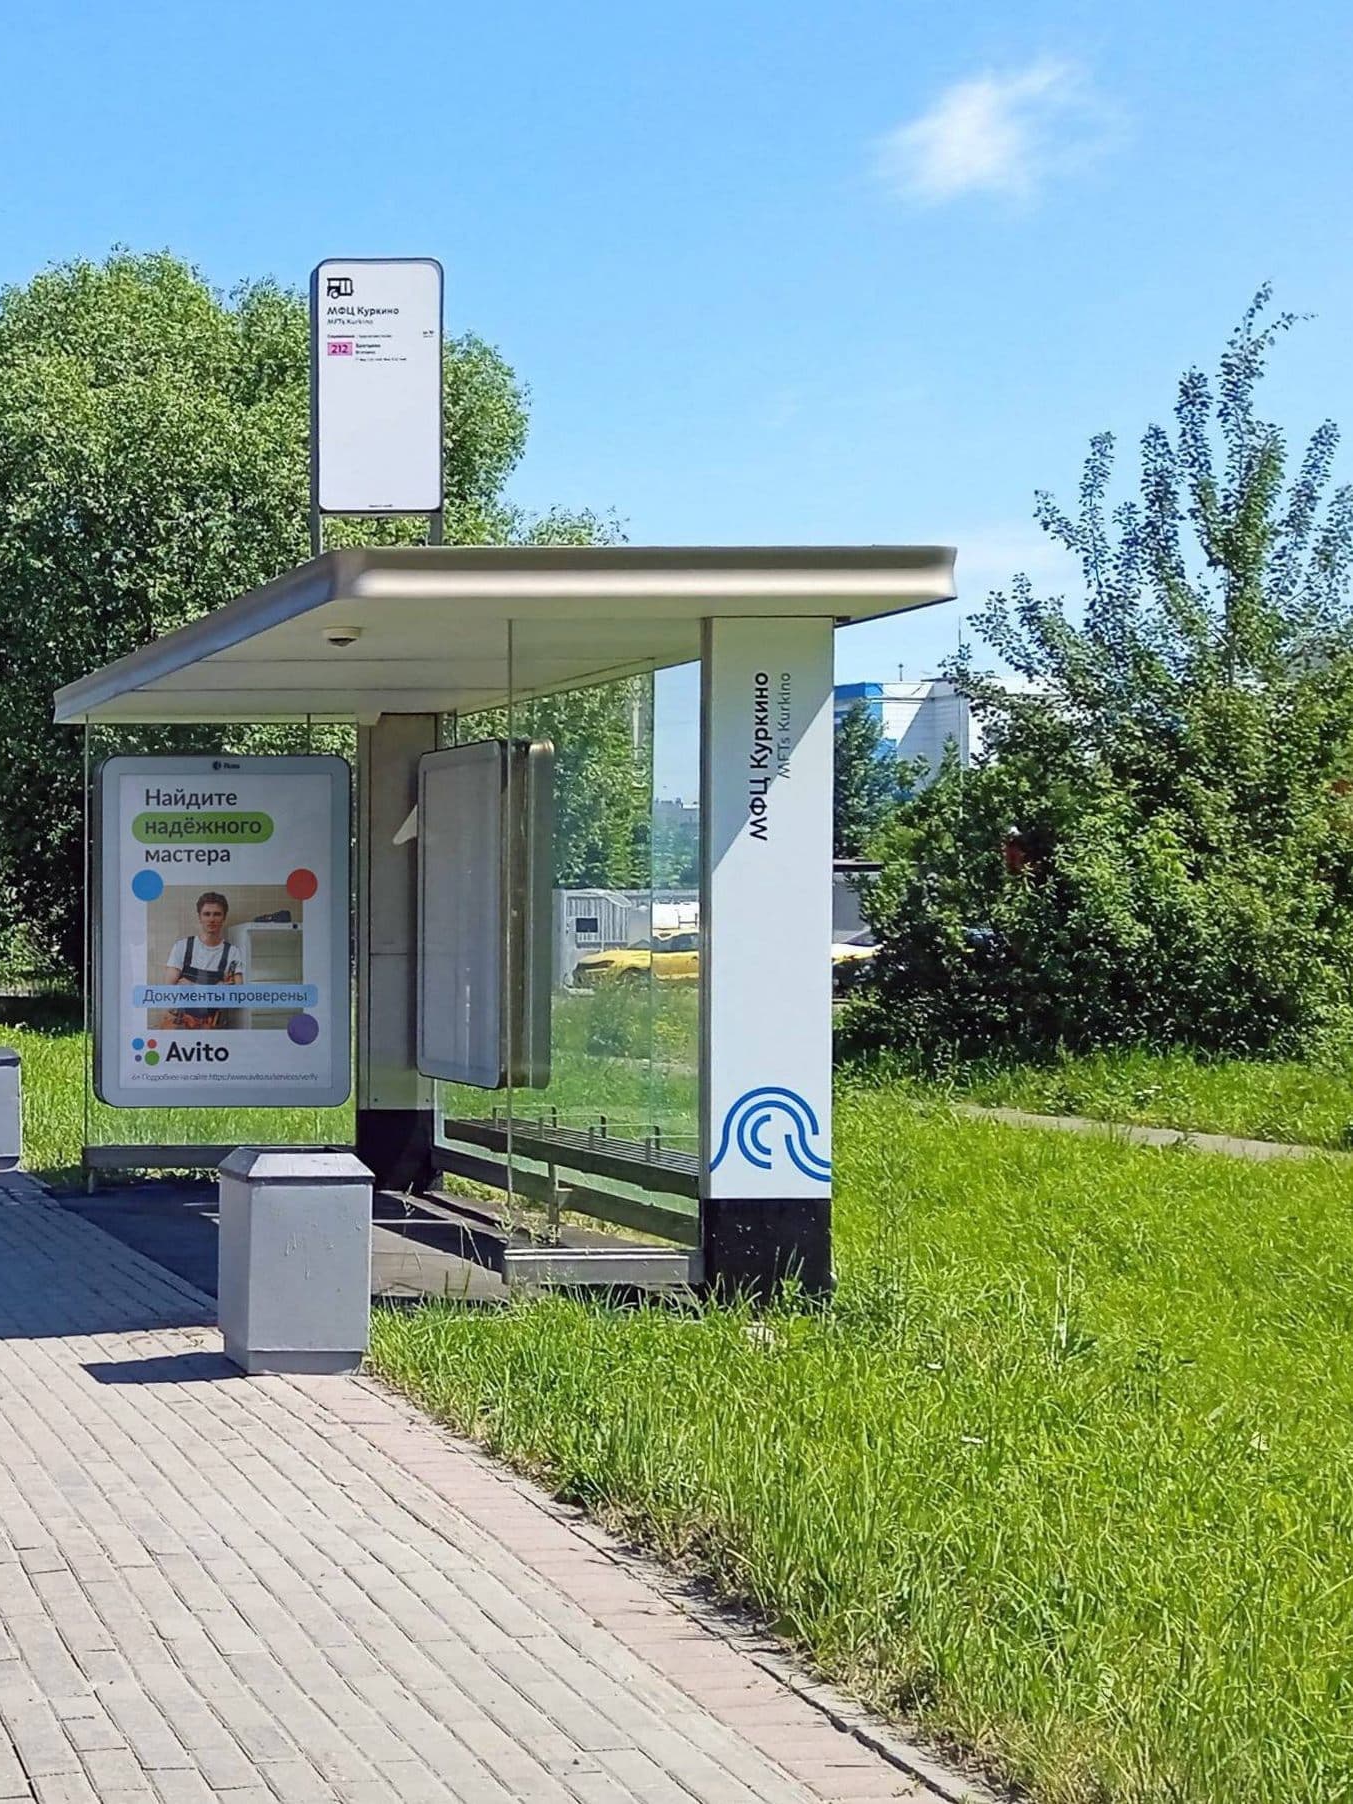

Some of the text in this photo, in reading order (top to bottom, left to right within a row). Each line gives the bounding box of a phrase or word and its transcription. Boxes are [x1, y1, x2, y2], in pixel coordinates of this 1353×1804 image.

[327, 306, 400, 317] МФЦ Куркино
[331, 344, 349, 355] 212
[777, 672, 791, 779] MFTs Kurkino
[749, 672, 773, 841] МФЦ Куркино
[145, 789, 238, 809] Найдите
[145, 818, 262, 838] надёжного
[145, 849, 231, 866] мастера
[142, 989, 308, 1005] Документы проверены
[165, 1041, 230, 1062] Avito
